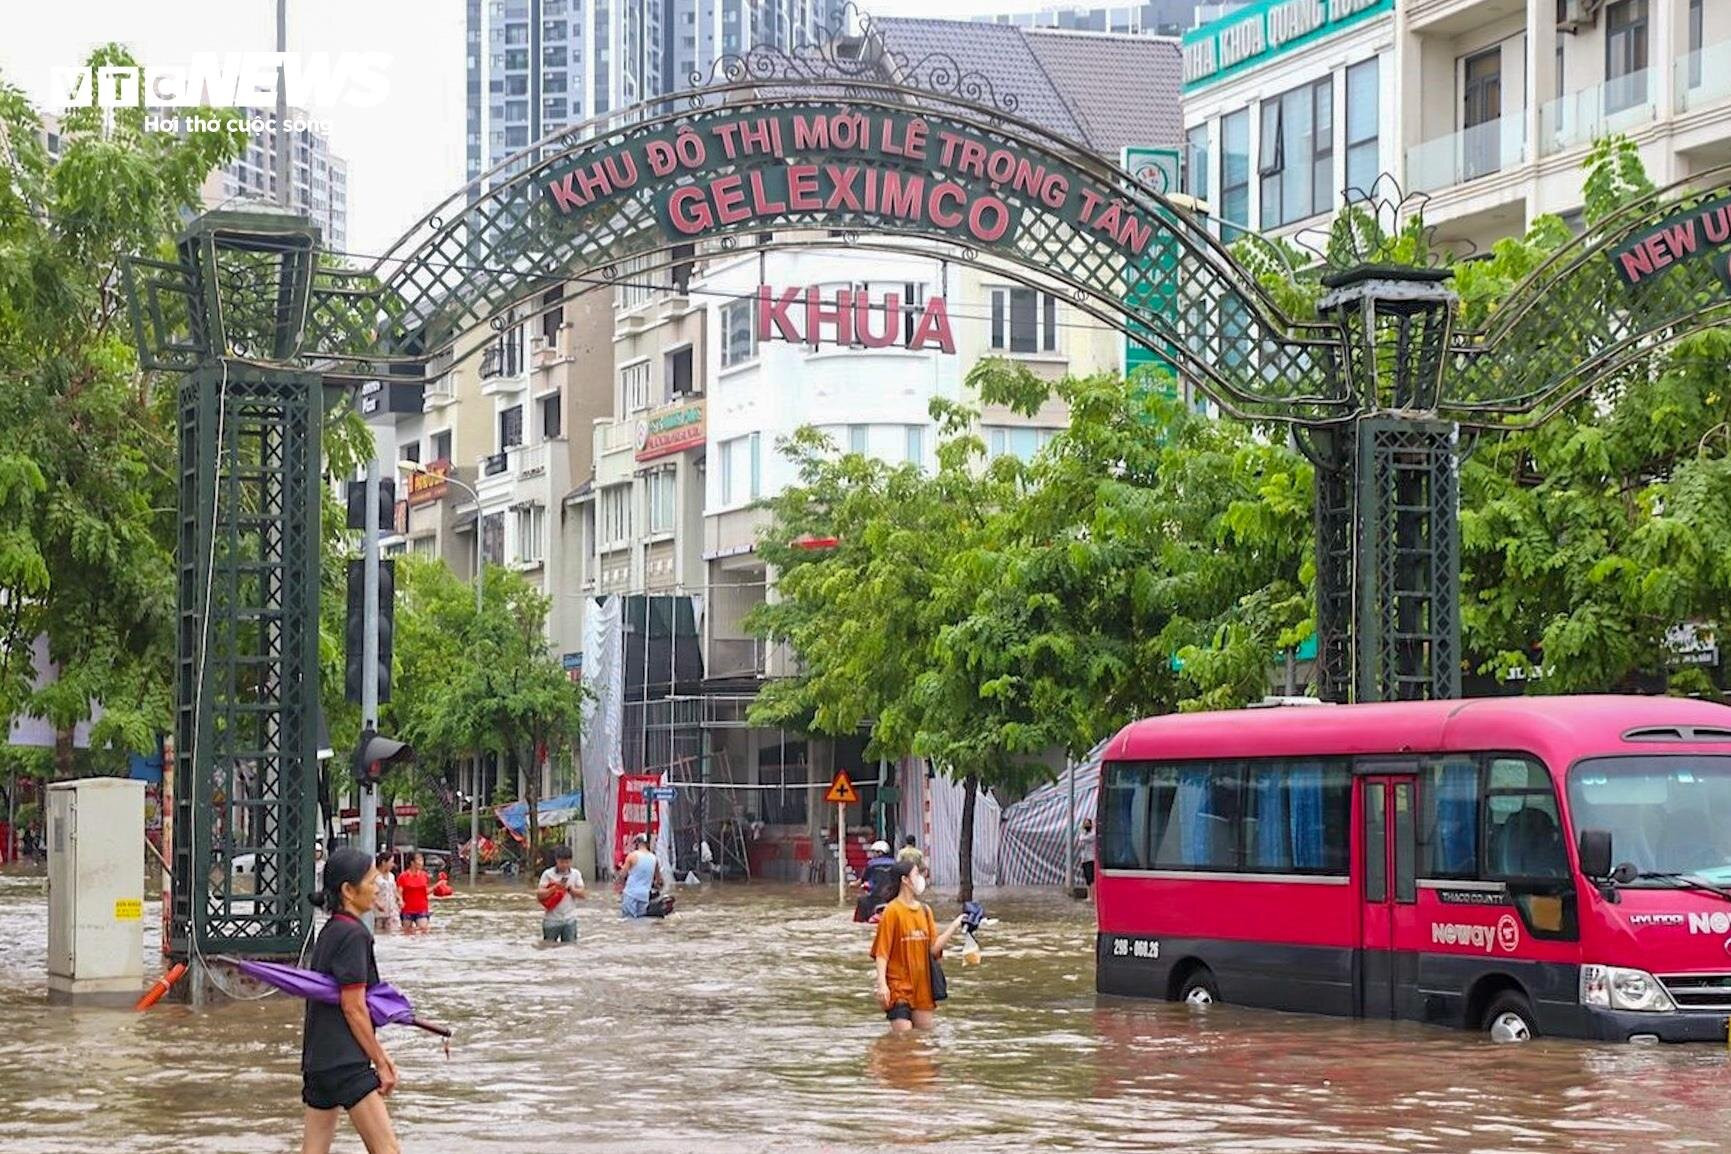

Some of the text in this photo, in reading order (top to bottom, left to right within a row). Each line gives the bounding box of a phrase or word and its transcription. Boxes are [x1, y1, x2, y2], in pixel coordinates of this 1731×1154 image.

[1219, 13, 1267, 70] KHOA
[550, 107, 1152, 255] KHU ĐÔ THỊ MỚI LÊ TRỌNG TÂN
[667, 165, 1010, 242] GELEXIMCO
[1619, 219, 1697, 283] NEW
[1701, 204, 1731, 243] U
